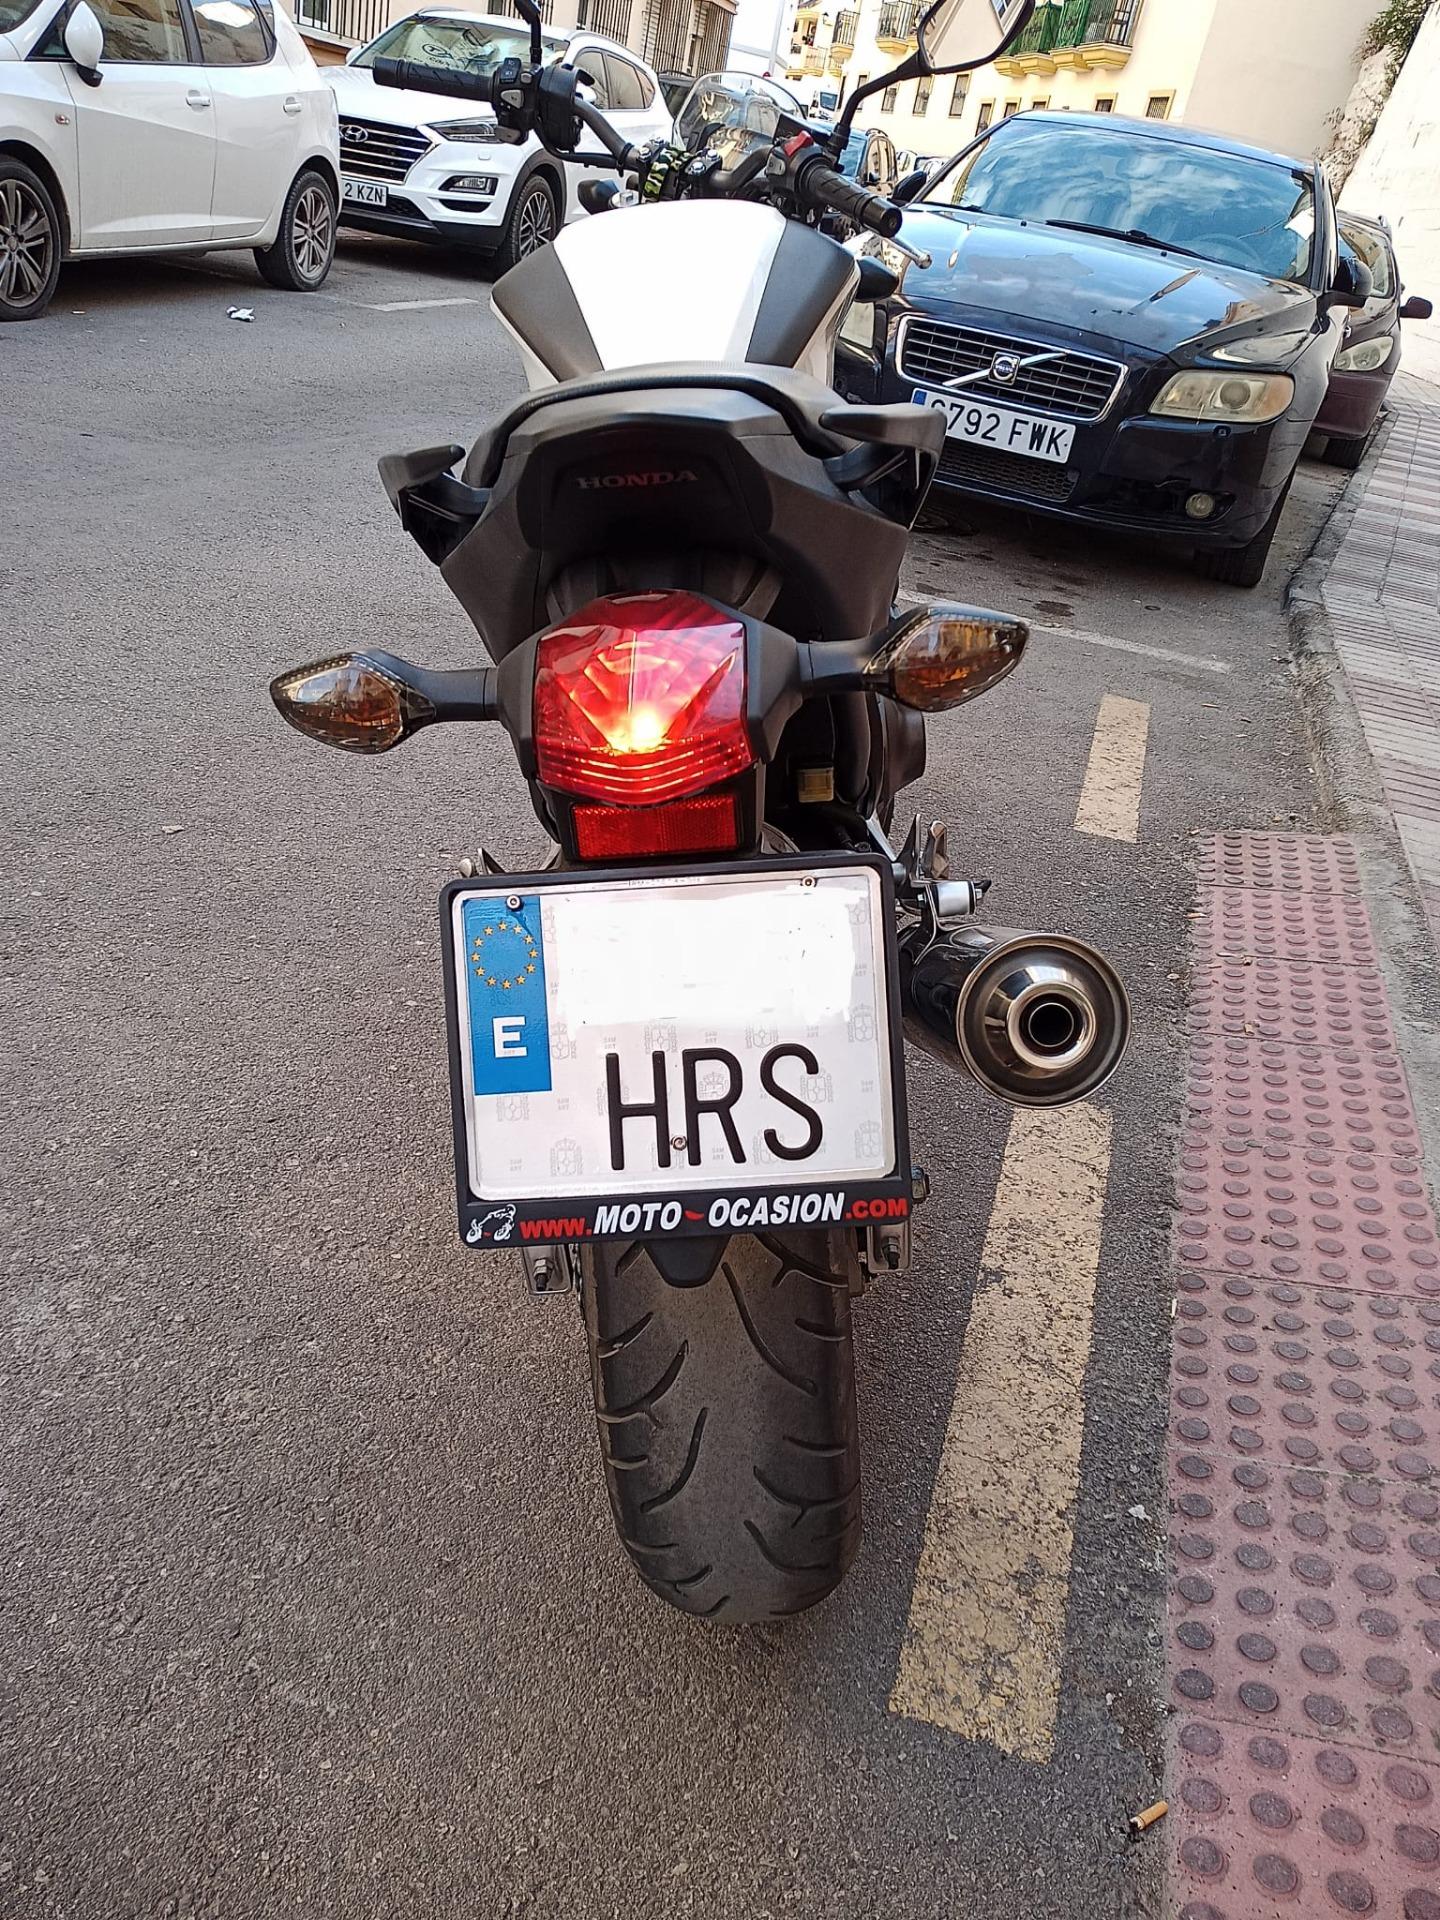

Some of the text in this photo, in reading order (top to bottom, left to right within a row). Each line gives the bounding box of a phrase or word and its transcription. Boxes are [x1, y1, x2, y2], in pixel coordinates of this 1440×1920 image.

[357, 184, 383, 203] KZN
[1007, 418, 1068, 457] FWK
[576, 469, 699, 489] HONDA
[492, 1015, 528, 1059] E
[605, 1042, 824, 1172] HRS
